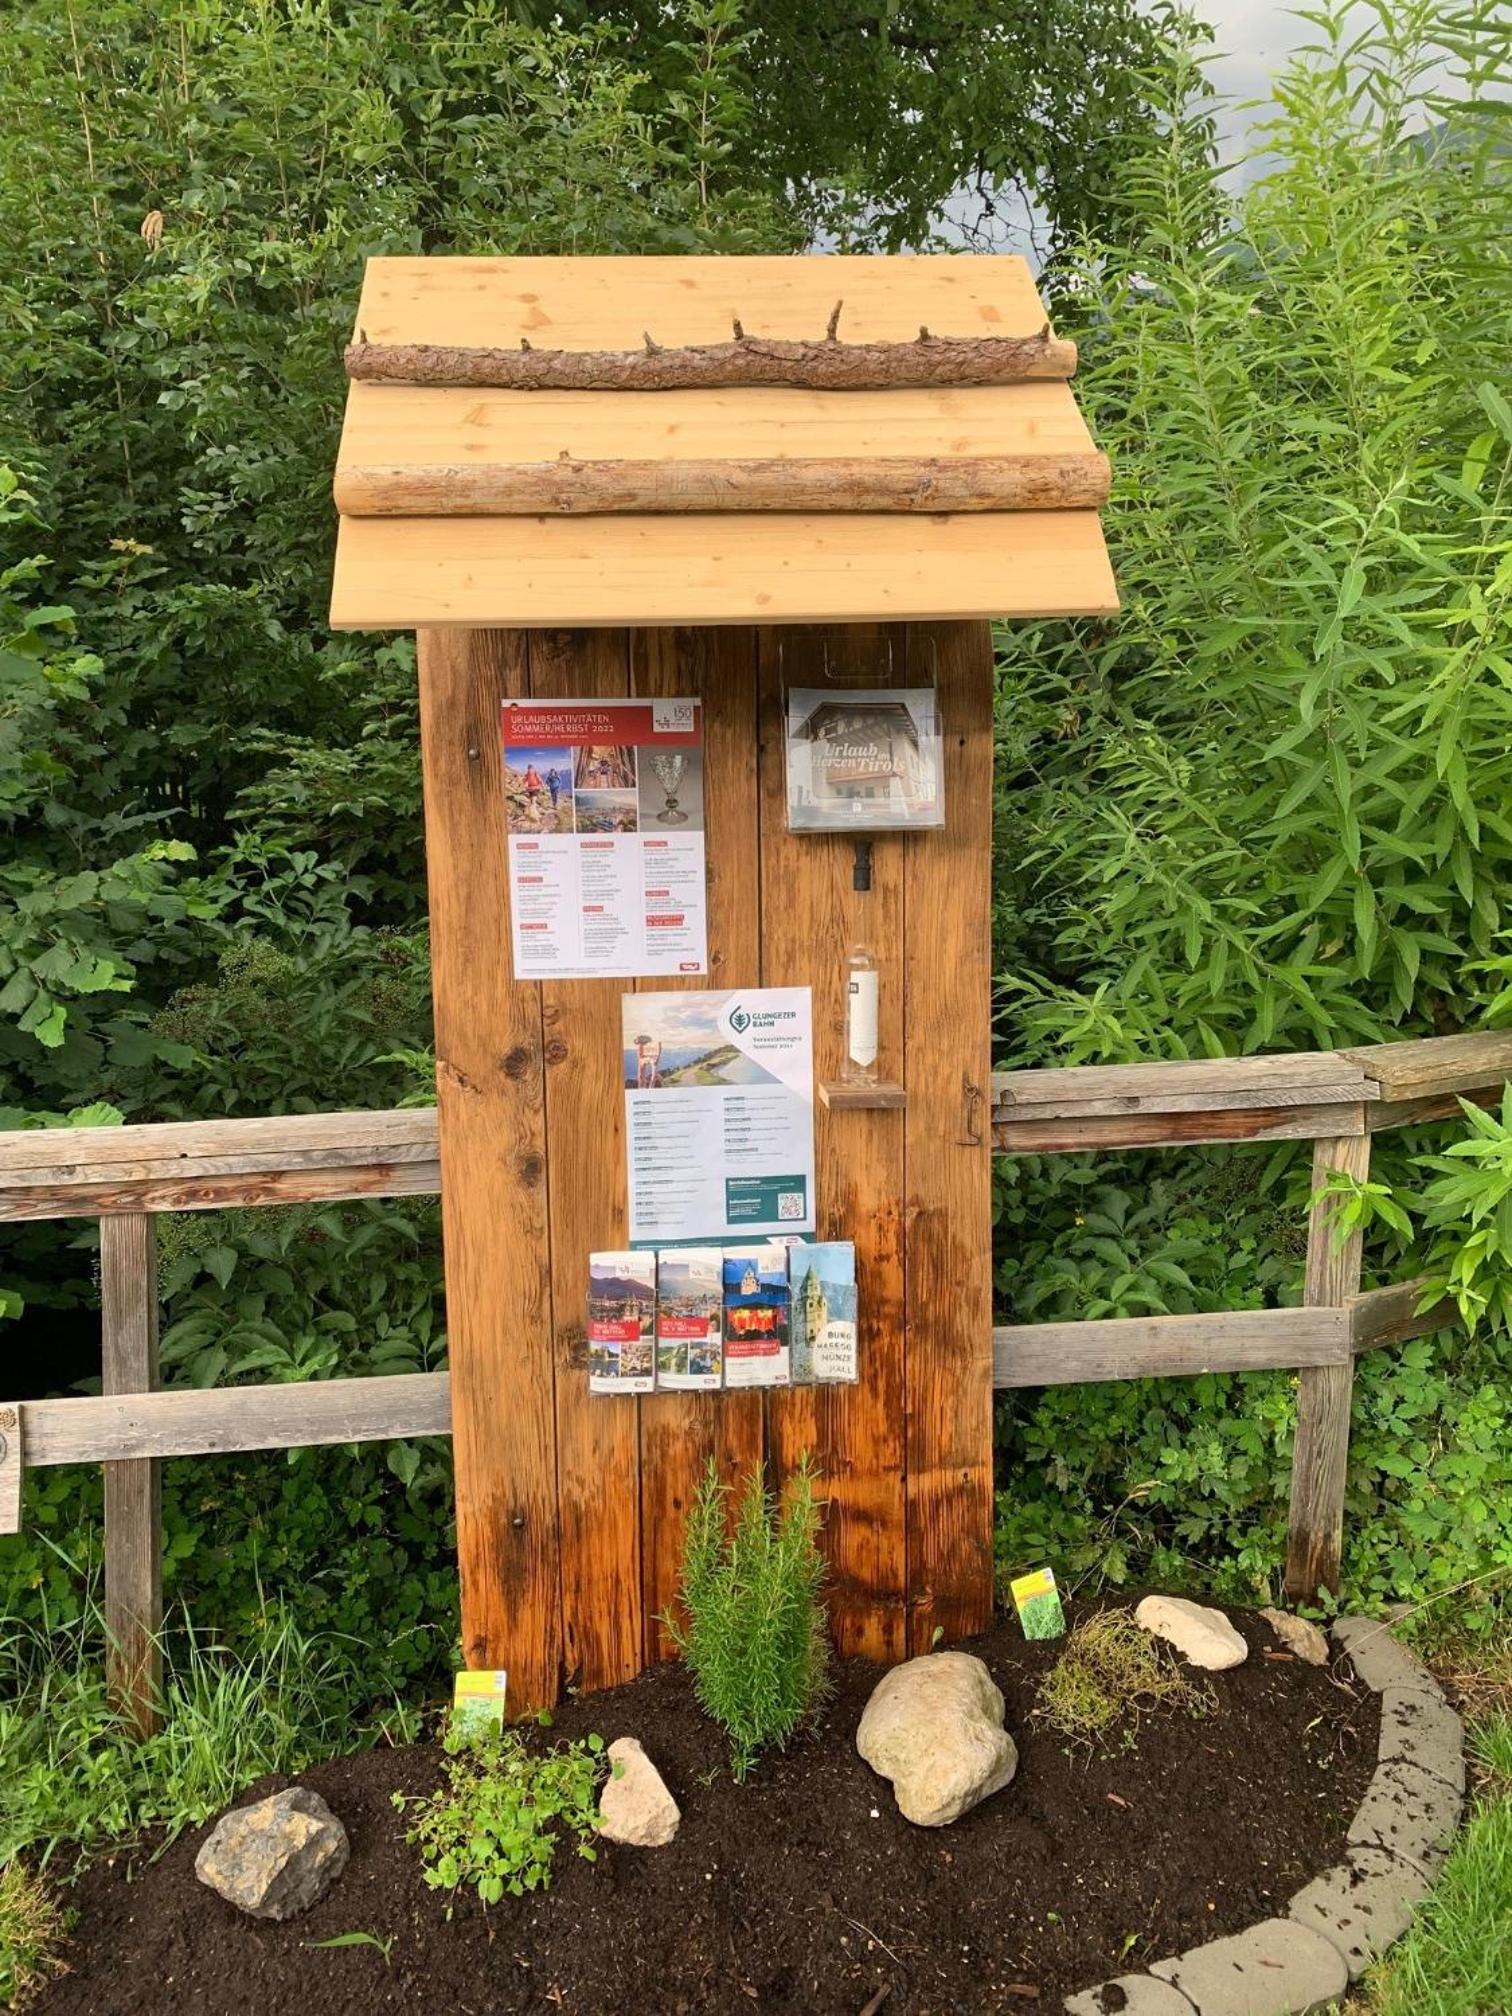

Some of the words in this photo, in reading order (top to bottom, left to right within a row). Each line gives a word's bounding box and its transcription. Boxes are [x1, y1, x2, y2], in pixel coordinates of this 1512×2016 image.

[511, 714, 609, 724] URLAUBSAKTIVITÄTEN
[511, 724, 589, 734] SOMMER/HERBST
[825, 742, 878, 757] Urlaub
[858, 758, 906, 775] Tirols
[752, 1011, 797, 1020] GLUNGEZER
[828, 1331, 852, 1340] BURG
